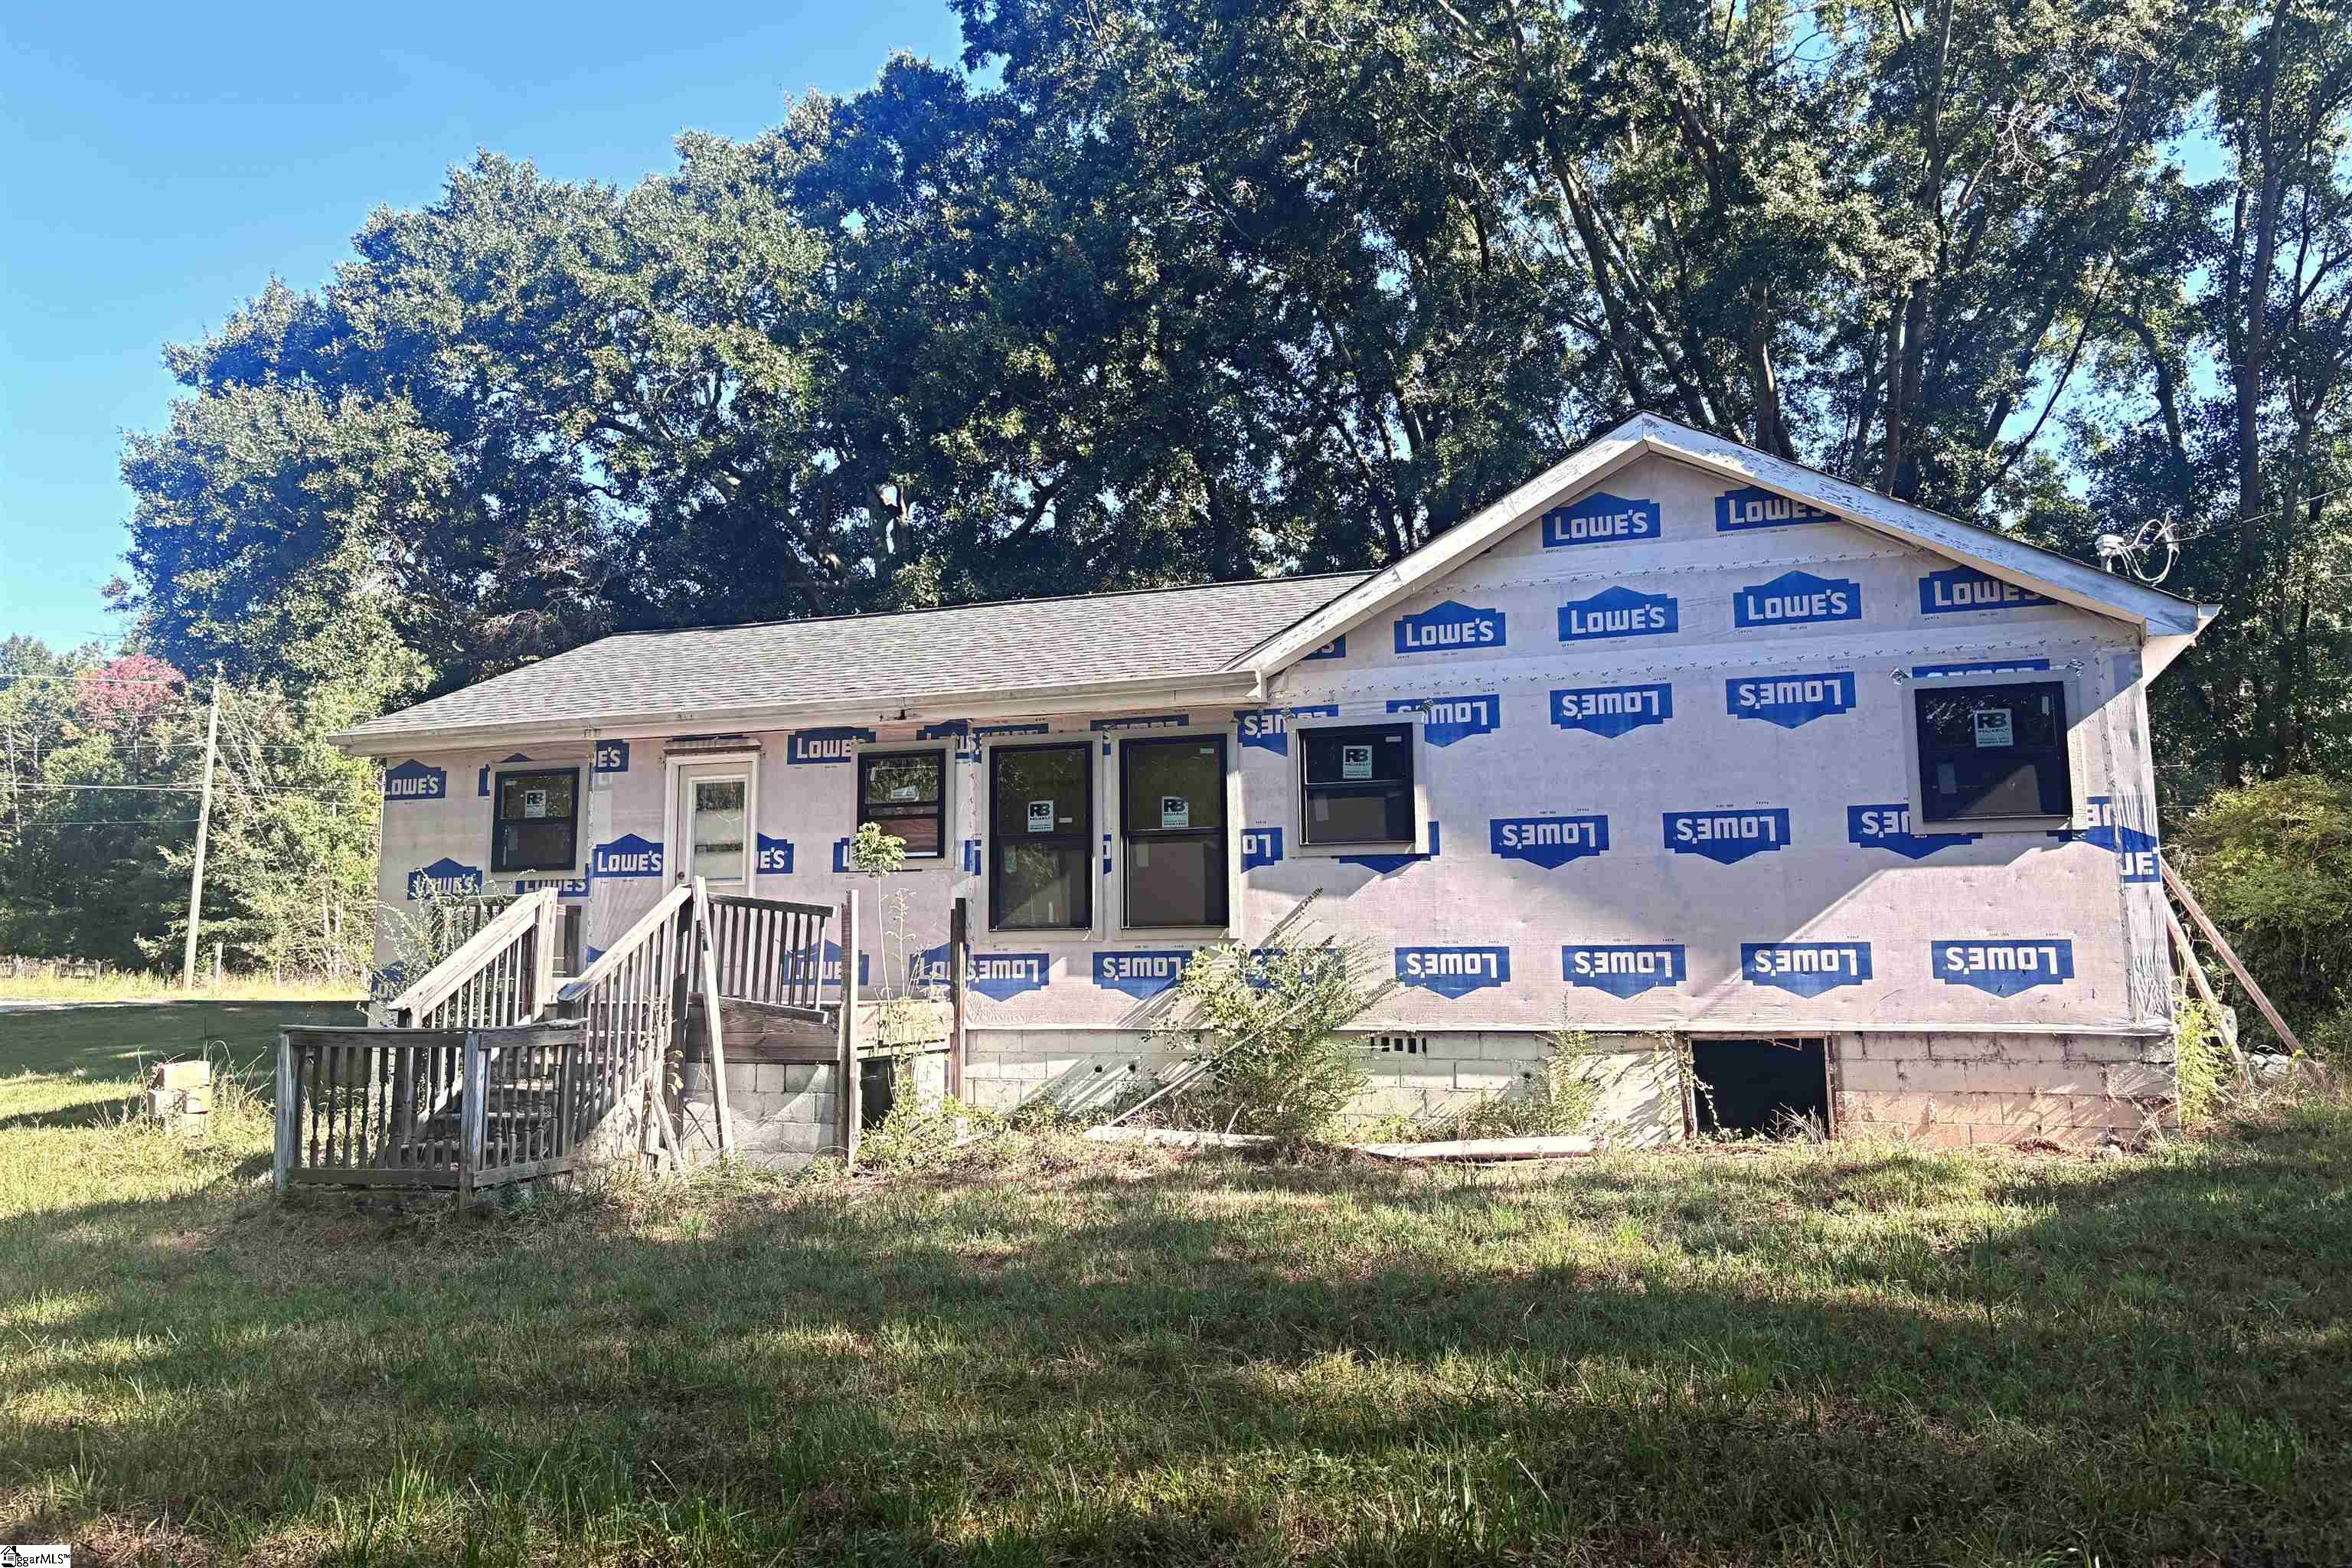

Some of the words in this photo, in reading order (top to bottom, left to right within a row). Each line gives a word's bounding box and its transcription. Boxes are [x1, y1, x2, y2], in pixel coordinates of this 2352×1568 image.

[1555, 509, 1648, 540] LOWE'S
[1729, 499, 1826, 524] LOWE
[1747, 589, 1848, 620] LOWE'S
[1934, 580, 2042, 606] LOWE
[1406, 619, 1495, 647] LOWE'S
[1571, 603, 1667, 635] LOWE'S
[1561, 691, 1660, 720] LOWE'S
[1740, 680, 1842, 710] LOWE'S
[1502, 822, 1596, 850] LOWE'S
[1676, 815, 1777, 844] LOWE'S
[598, 851, 662, 872] LOWE'S
[1103, 957, 1181, 981] LOWE'S
[1406, 952, 1499, 979] LOWE'S
[1574, 951, 1673, 978] LOWE'S
[1754, 949, 1858, 976] LOWE'S
[1945, 946, 2059, 975] LOWE'S
